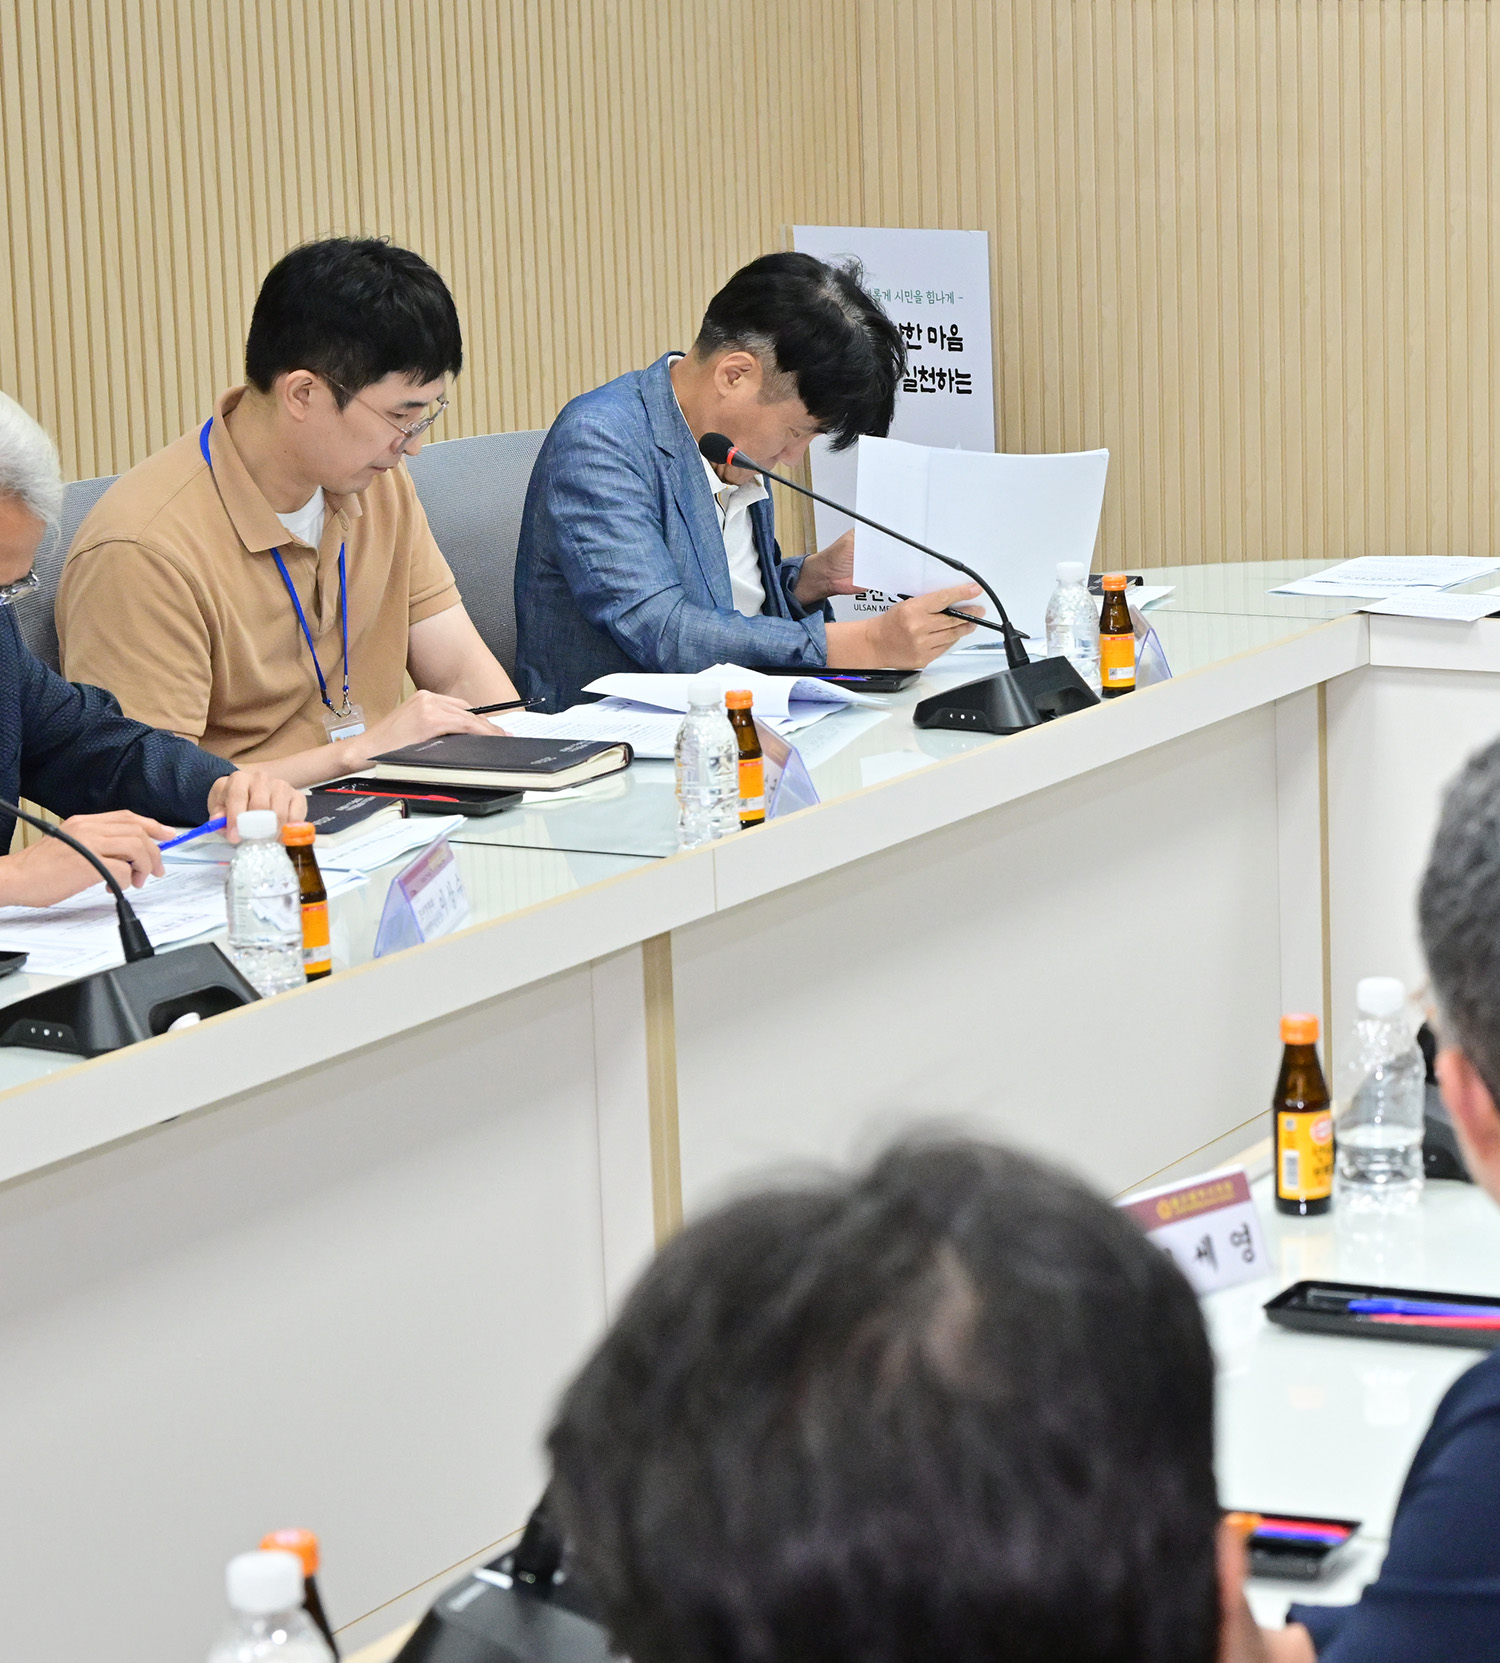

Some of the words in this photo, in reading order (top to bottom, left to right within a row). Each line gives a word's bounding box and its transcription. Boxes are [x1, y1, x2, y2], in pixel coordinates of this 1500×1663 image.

[895, 289, 923, 304] 시민을
[926, 290, 955, 305] 힘나게
[899, 322, 923, 350] 한
[927, 324, 964, 352] 마음
[902, 365, 973, 395] 실천하는
[853, 604, 877, 612] ULSAN
